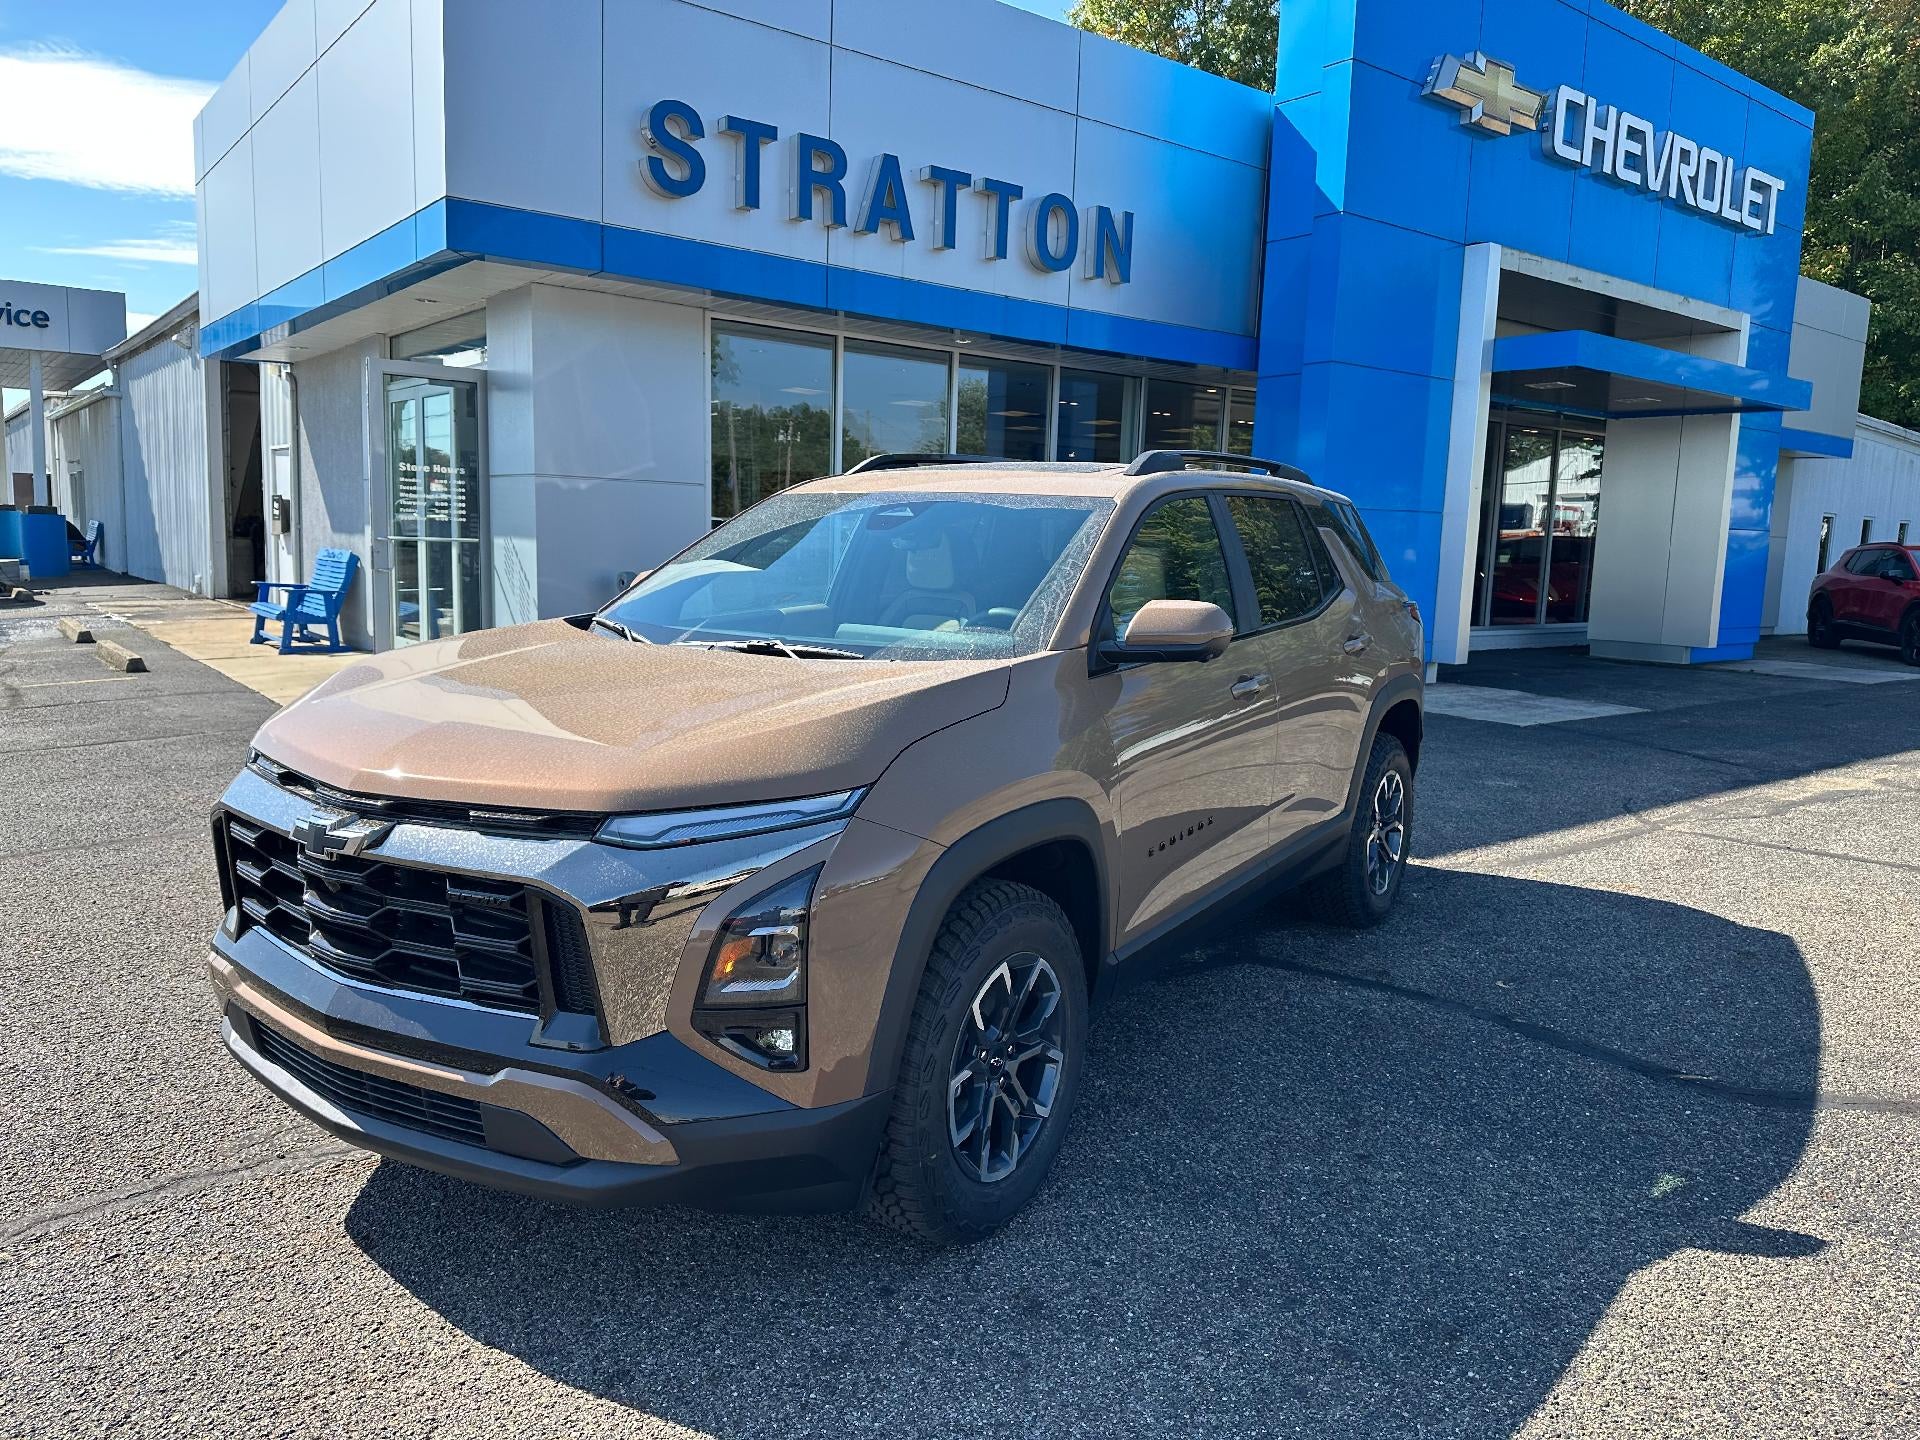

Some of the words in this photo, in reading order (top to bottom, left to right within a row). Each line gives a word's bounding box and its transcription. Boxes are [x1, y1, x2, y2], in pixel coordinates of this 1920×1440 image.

[640, 99, 1134, 285] STRATTON
[1552, 84, 1785, 235] CHEVROLET
[399, 462, 430, 473] Store
[433, 464, 466, 475] Hours
